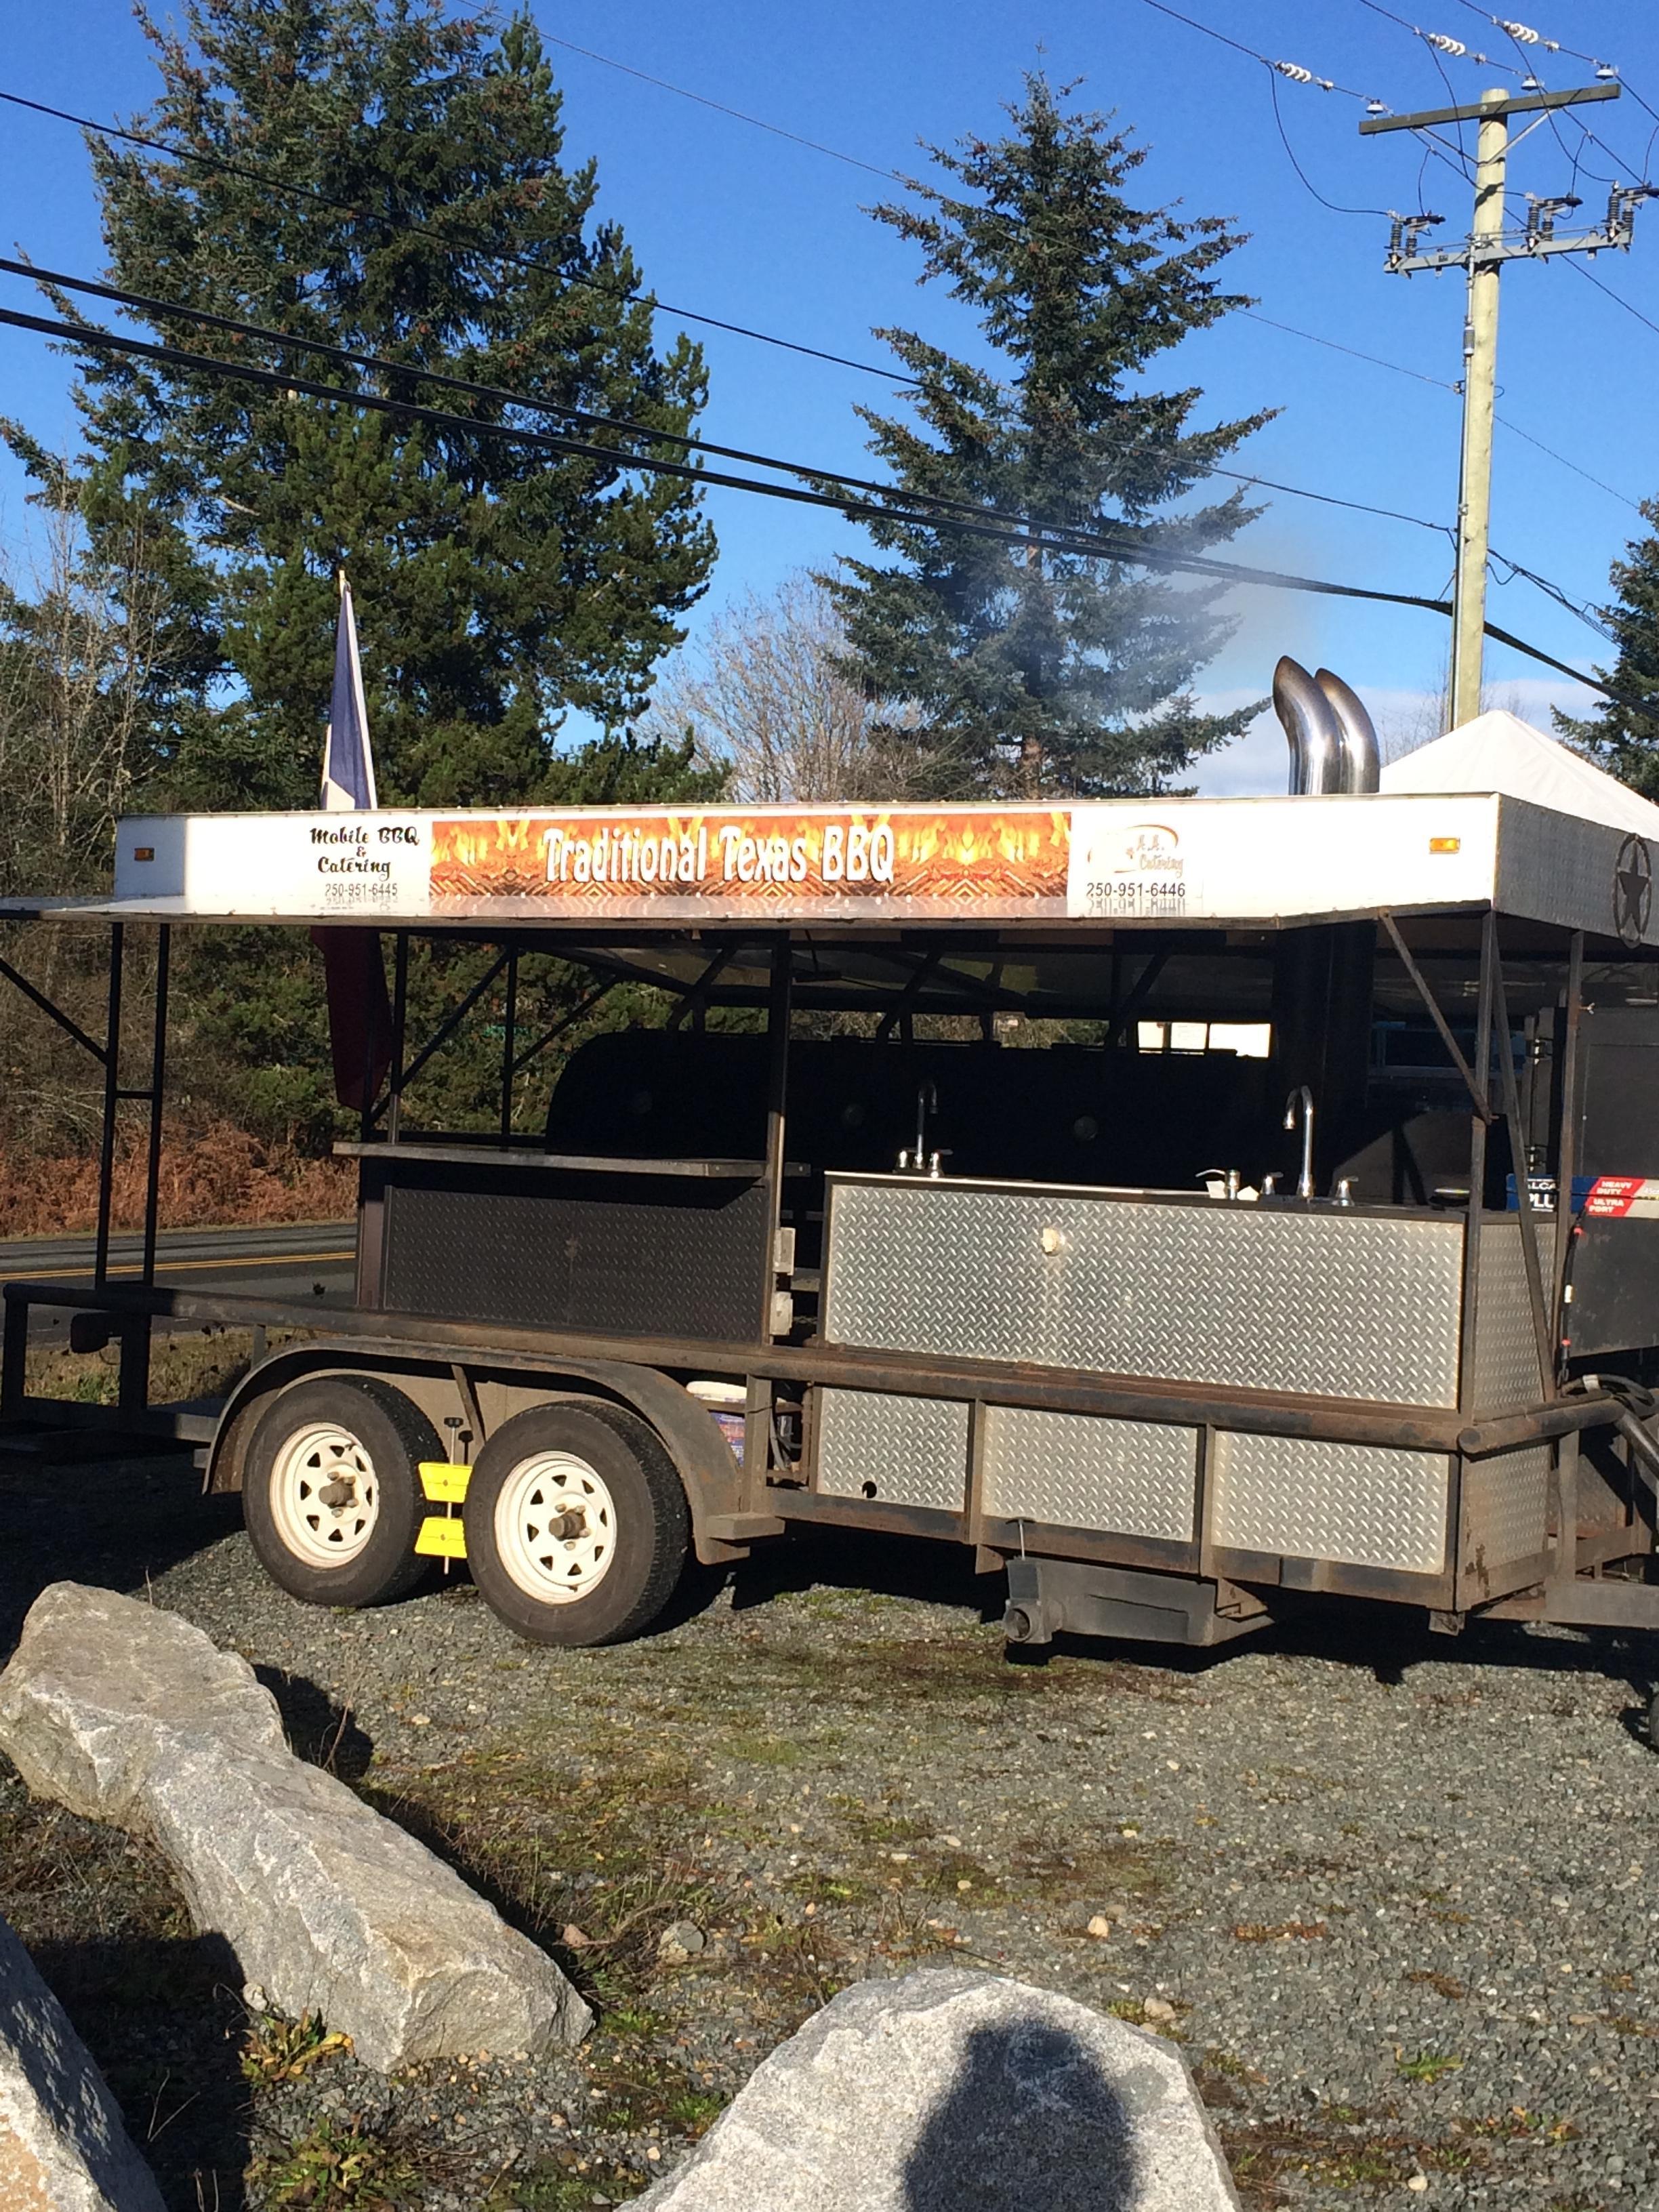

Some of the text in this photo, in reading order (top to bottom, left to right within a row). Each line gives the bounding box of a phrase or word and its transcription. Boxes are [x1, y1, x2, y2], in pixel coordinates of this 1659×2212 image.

[310, 826, 419, 846] Mobile BBQ
[356, 846, 367, 857] &
[543, 825, 893, 883] Traditional Texas BBQ
[318, 857, 390, 882] Catering
[1086, 882, 1185, 897] 250-951-6446
[1597, 1187, 1622, 1195] DUTY
[1601, 1181, 1633, 1189] HEAVY
[1593, 1197, 1624, 1207] ULTRA
